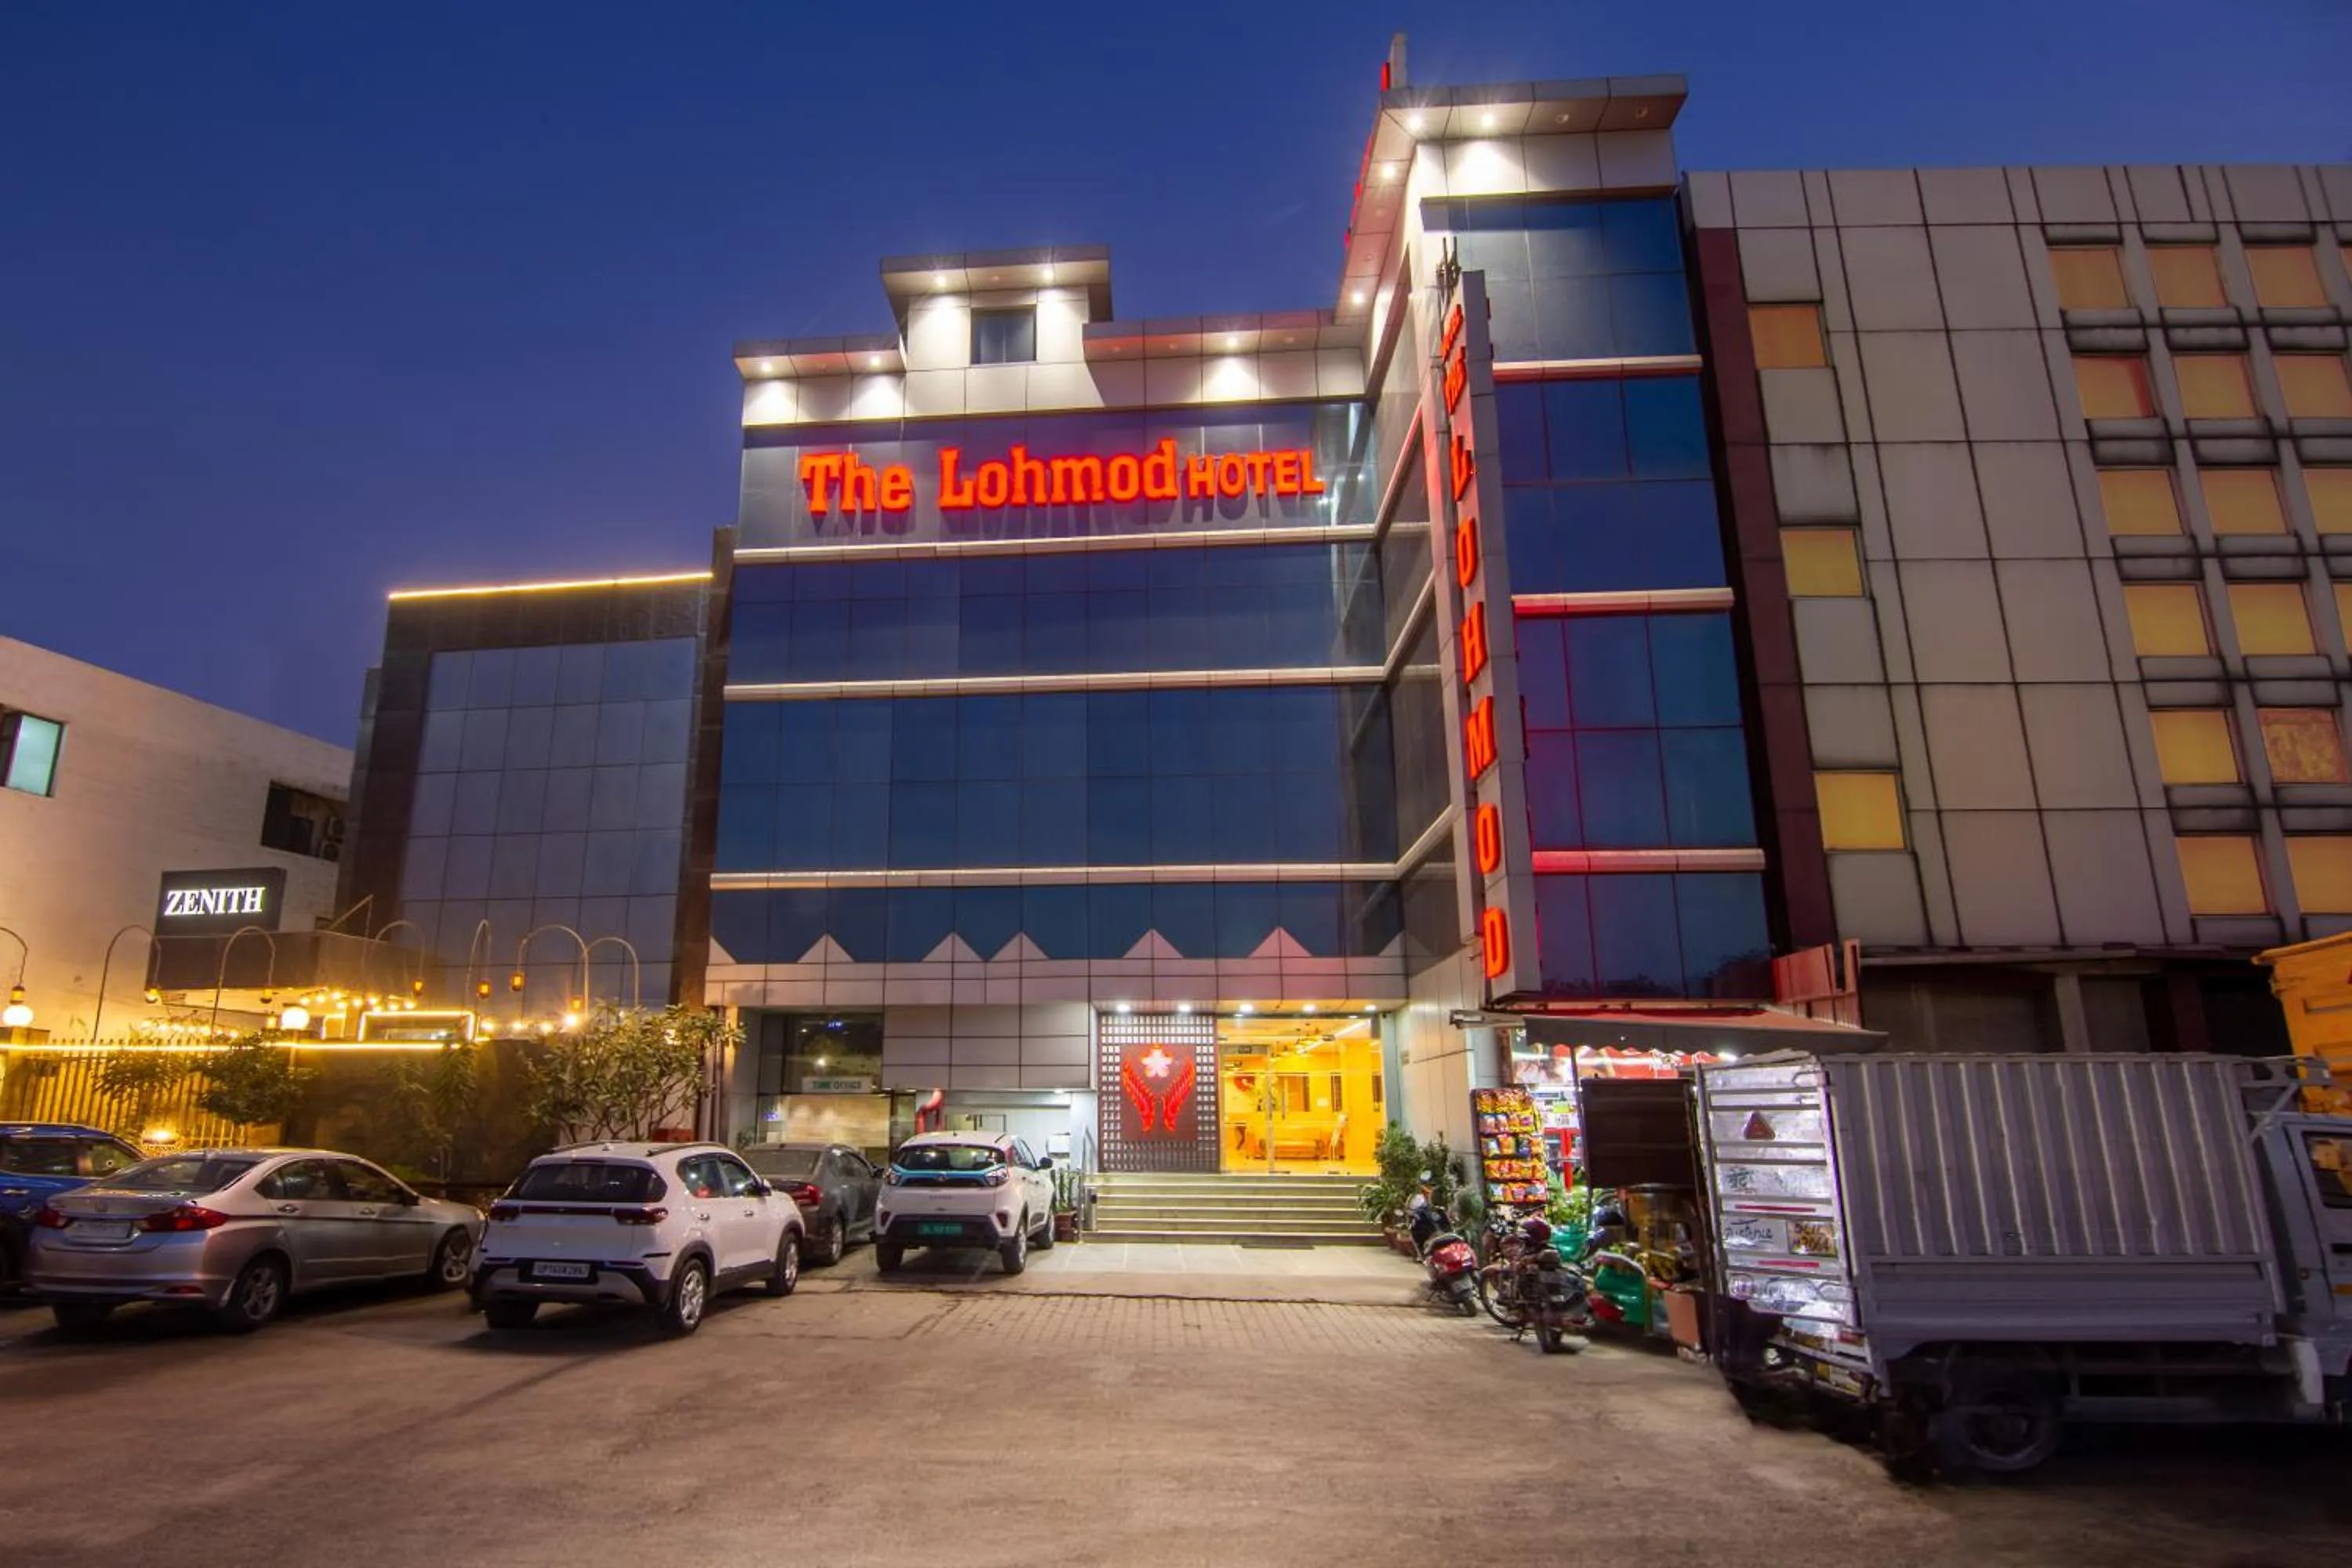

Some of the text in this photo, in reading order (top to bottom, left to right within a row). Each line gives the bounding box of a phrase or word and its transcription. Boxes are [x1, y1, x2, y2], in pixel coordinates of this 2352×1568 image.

[799, 438, 1327, 512] The Lohmod HOTEL
[164, 887, 266, 916] ZENITH
